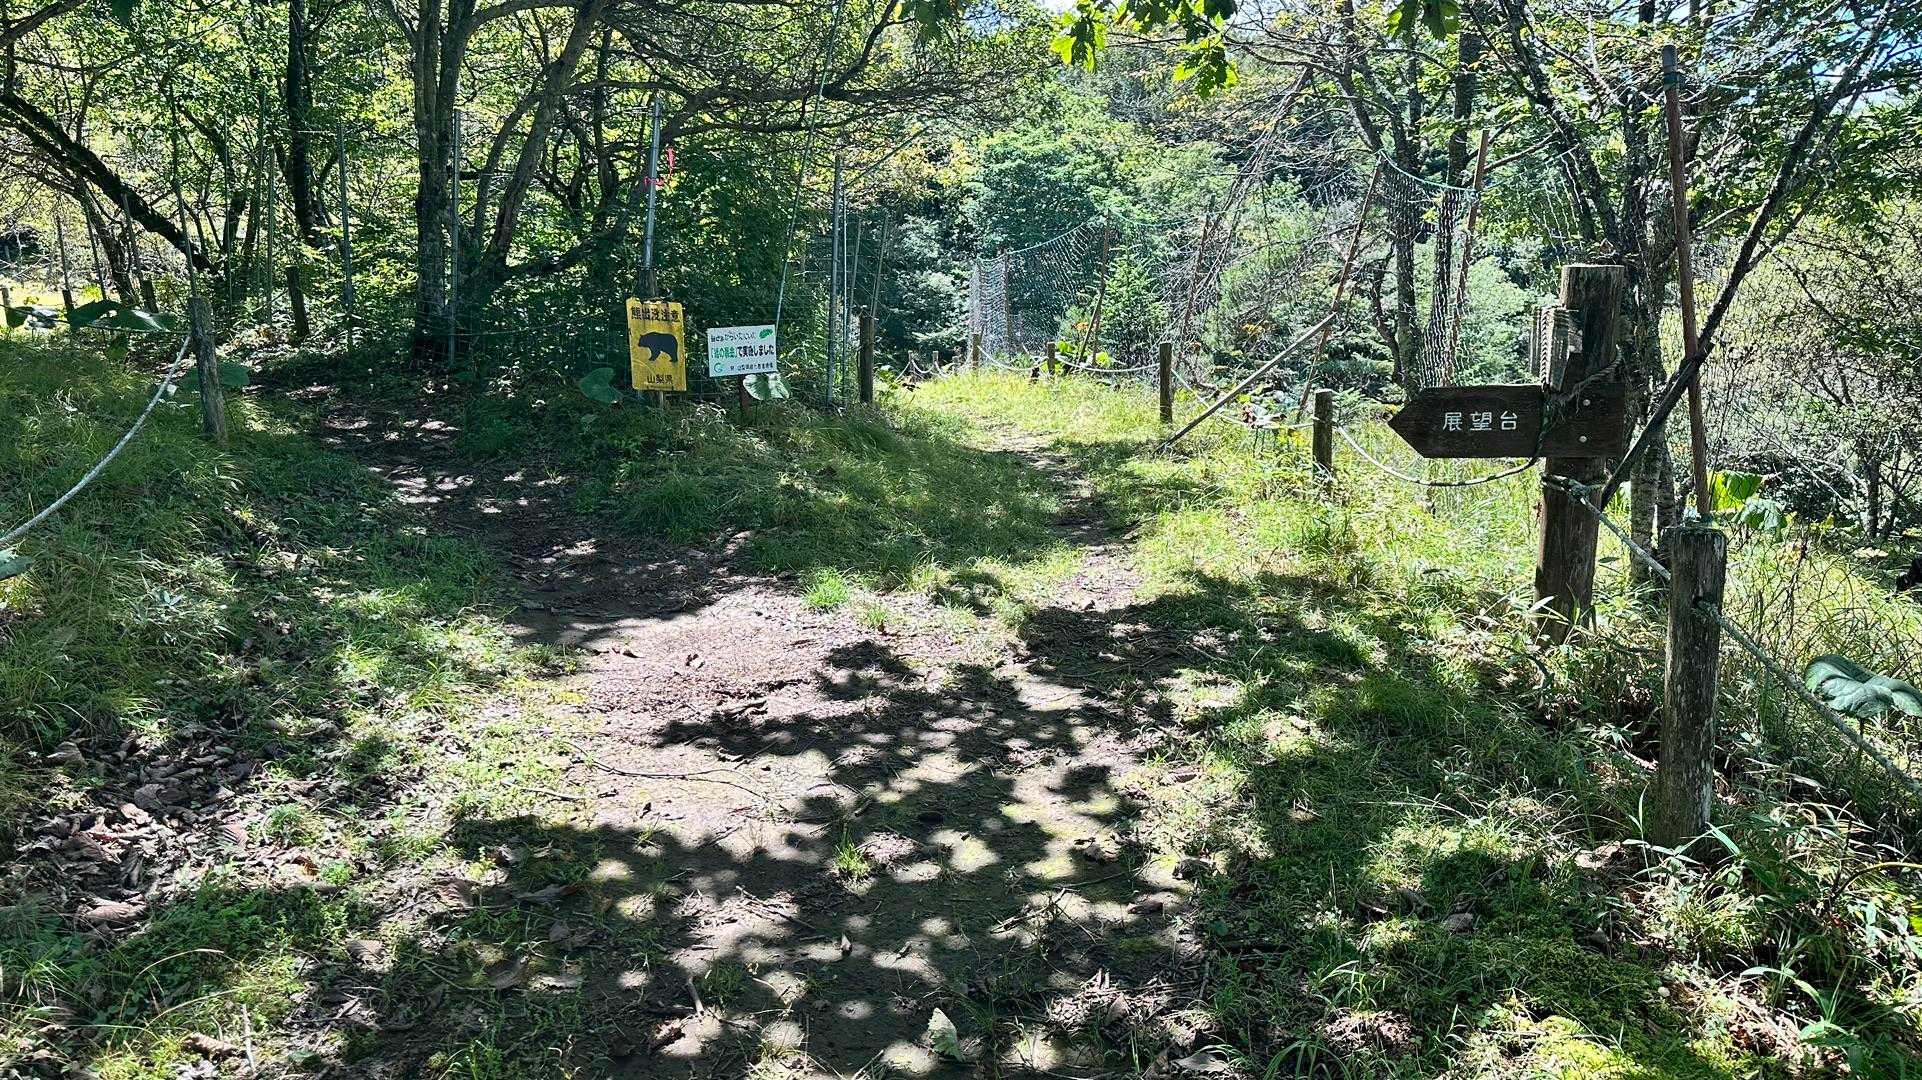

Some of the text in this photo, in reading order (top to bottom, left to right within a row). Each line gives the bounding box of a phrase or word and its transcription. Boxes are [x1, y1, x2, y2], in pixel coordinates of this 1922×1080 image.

[631, 305, 680, 323] 熊出没注意
[647, 373, 673, 385] 山梨県
[1442, 410, 1518, 432] 展望台
